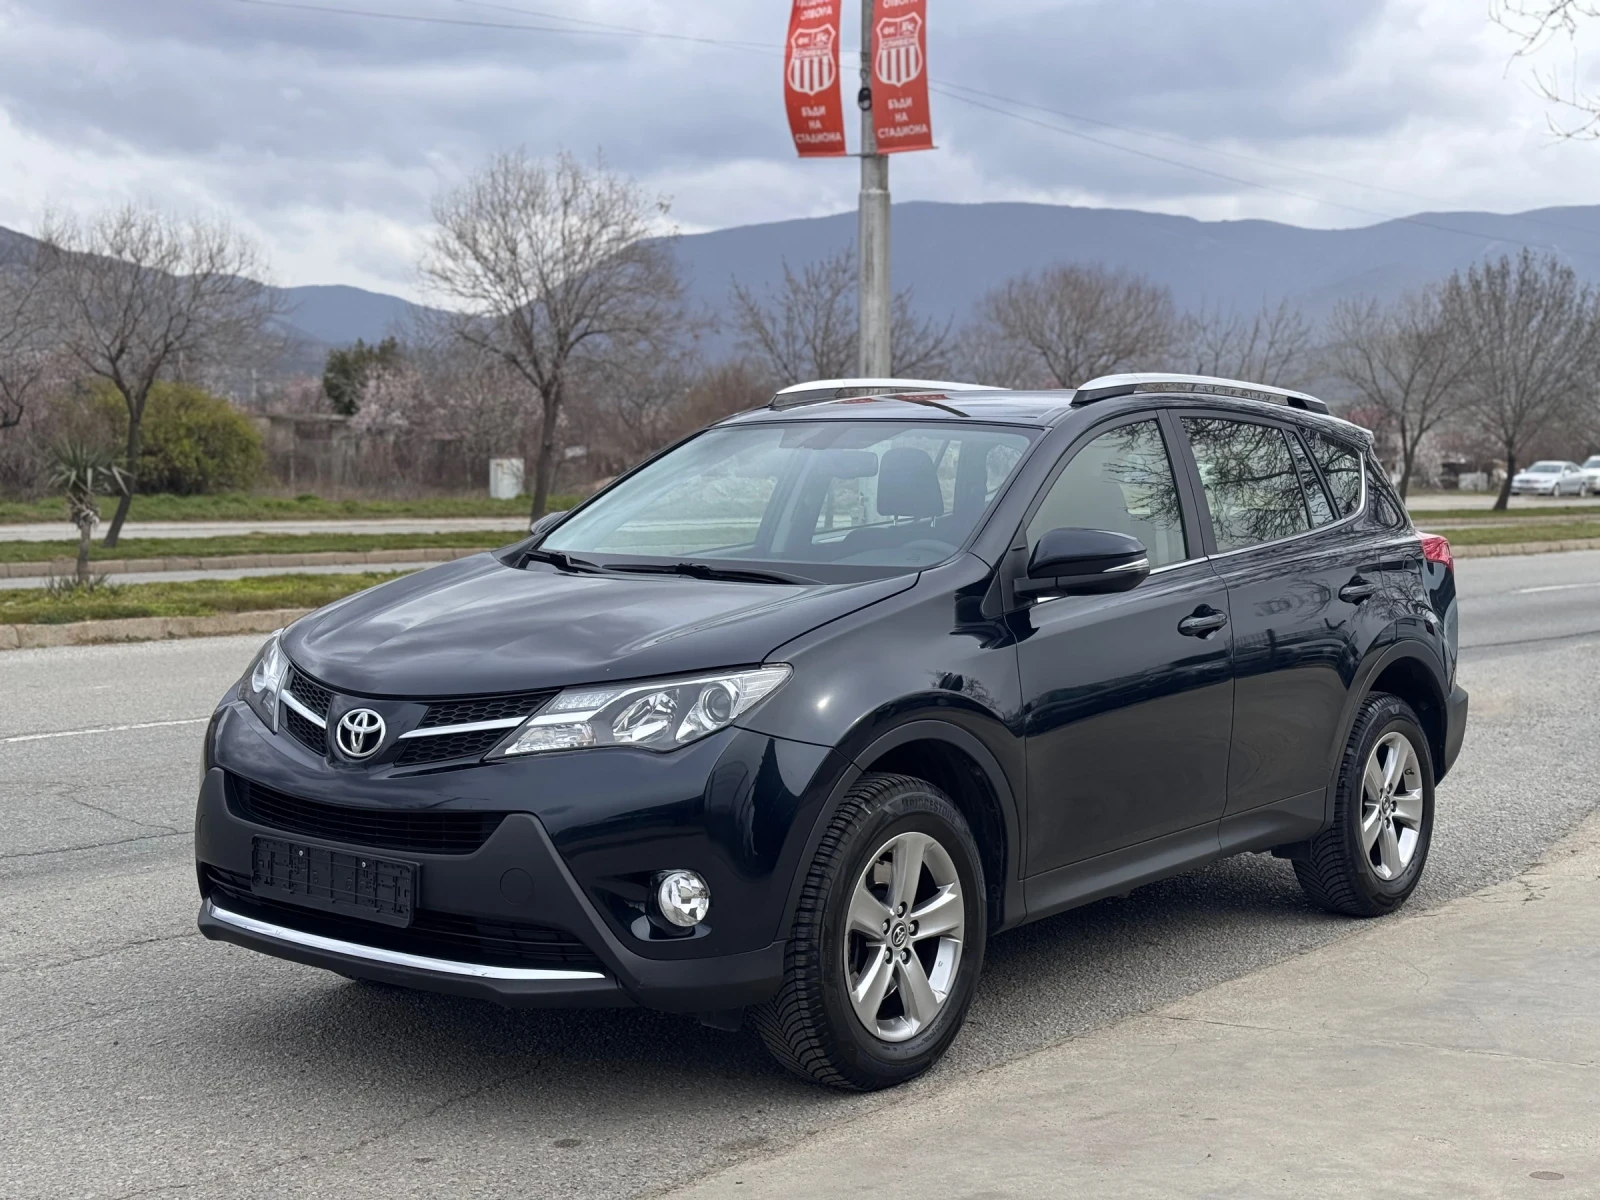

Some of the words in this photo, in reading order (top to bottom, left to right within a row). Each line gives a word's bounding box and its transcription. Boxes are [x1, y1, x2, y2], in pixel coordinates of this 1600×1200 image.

[895, 112, 908, 122] НА
[808, 119, 822, 129] НА
[878, 124, 929, 138] СТАДИОНА
[795, 131, 842, 143] СТАДИОНА
